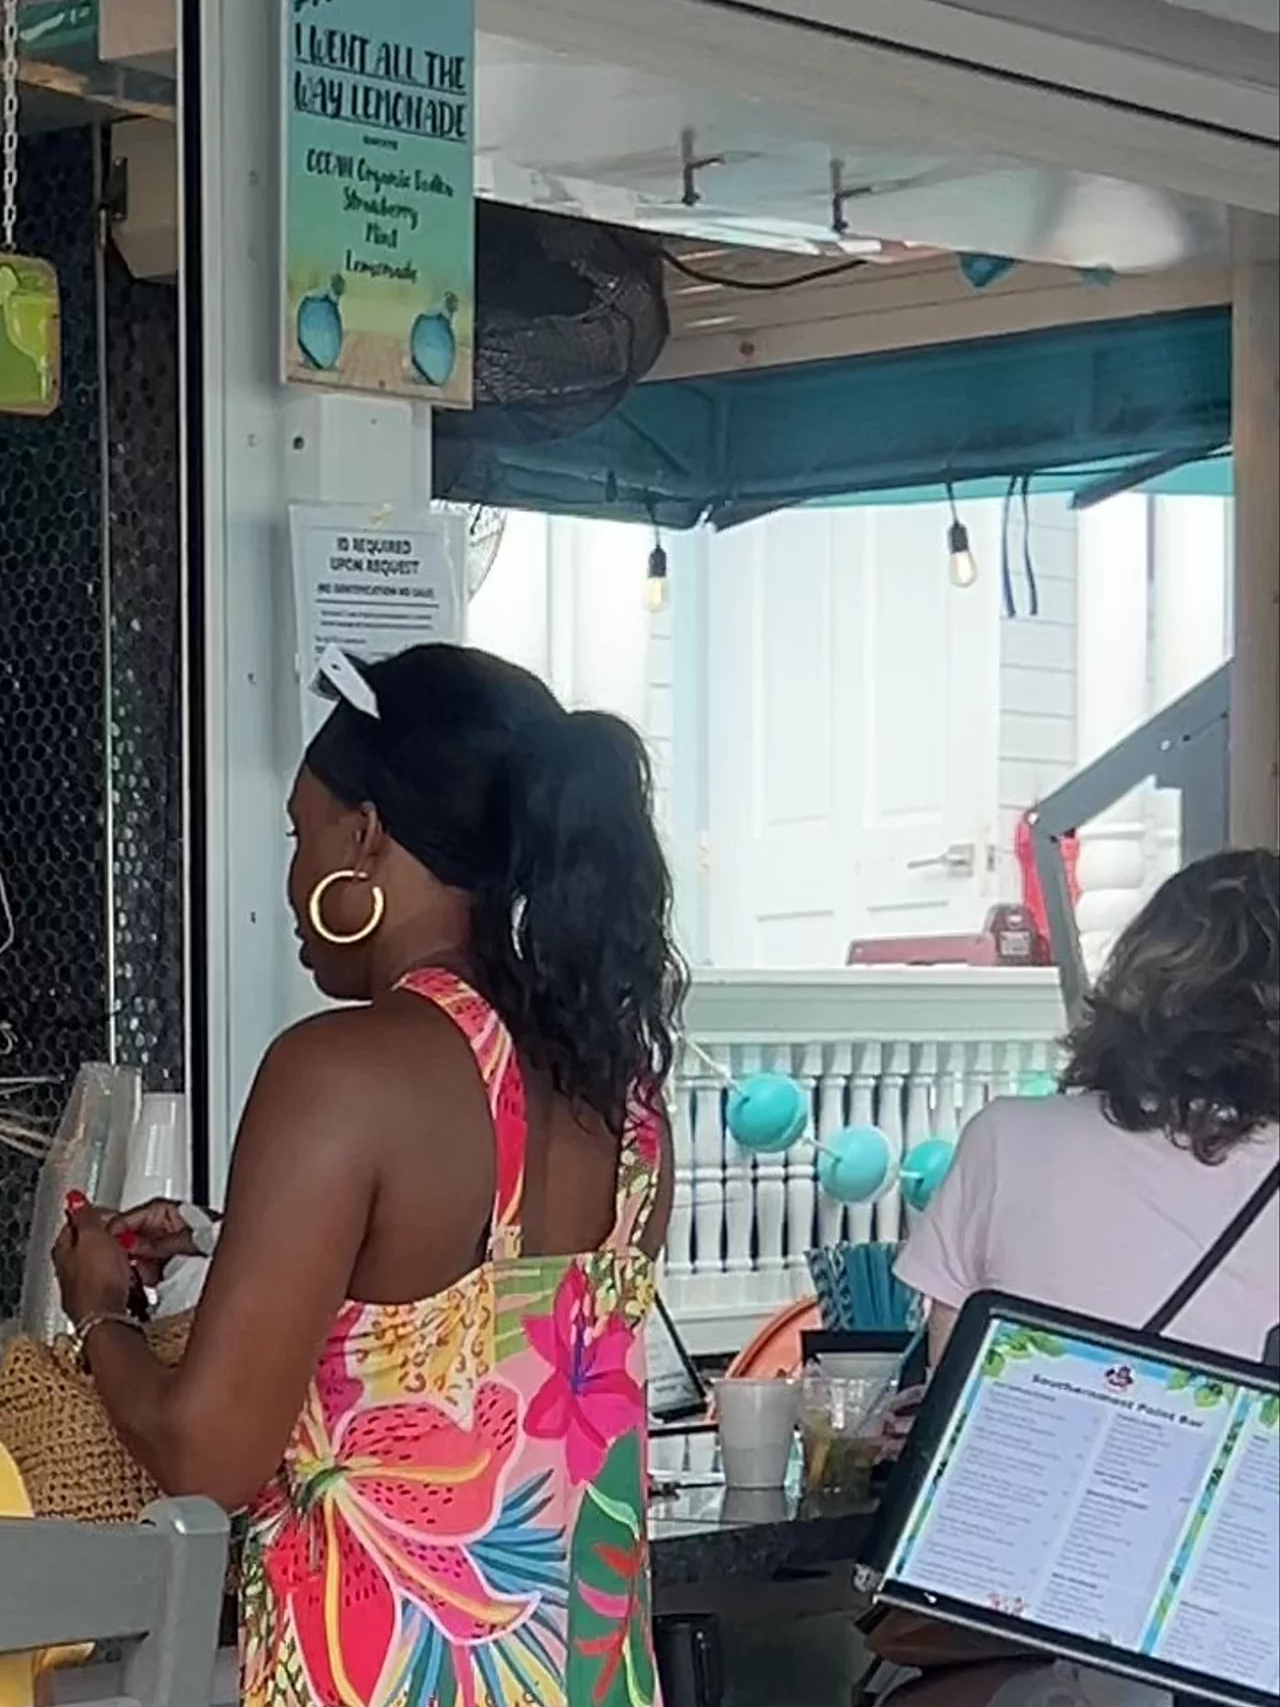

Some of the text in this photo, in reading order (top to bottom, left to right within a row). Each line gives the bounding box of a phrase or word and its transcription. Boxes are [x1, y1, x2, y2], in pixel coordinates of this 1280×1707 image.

[295, 22, 466, 90] I WENT ALL THE
[294, 71, 467, 138] WAY LEMONADE
[342, 185, 419, 230] Strawberry
